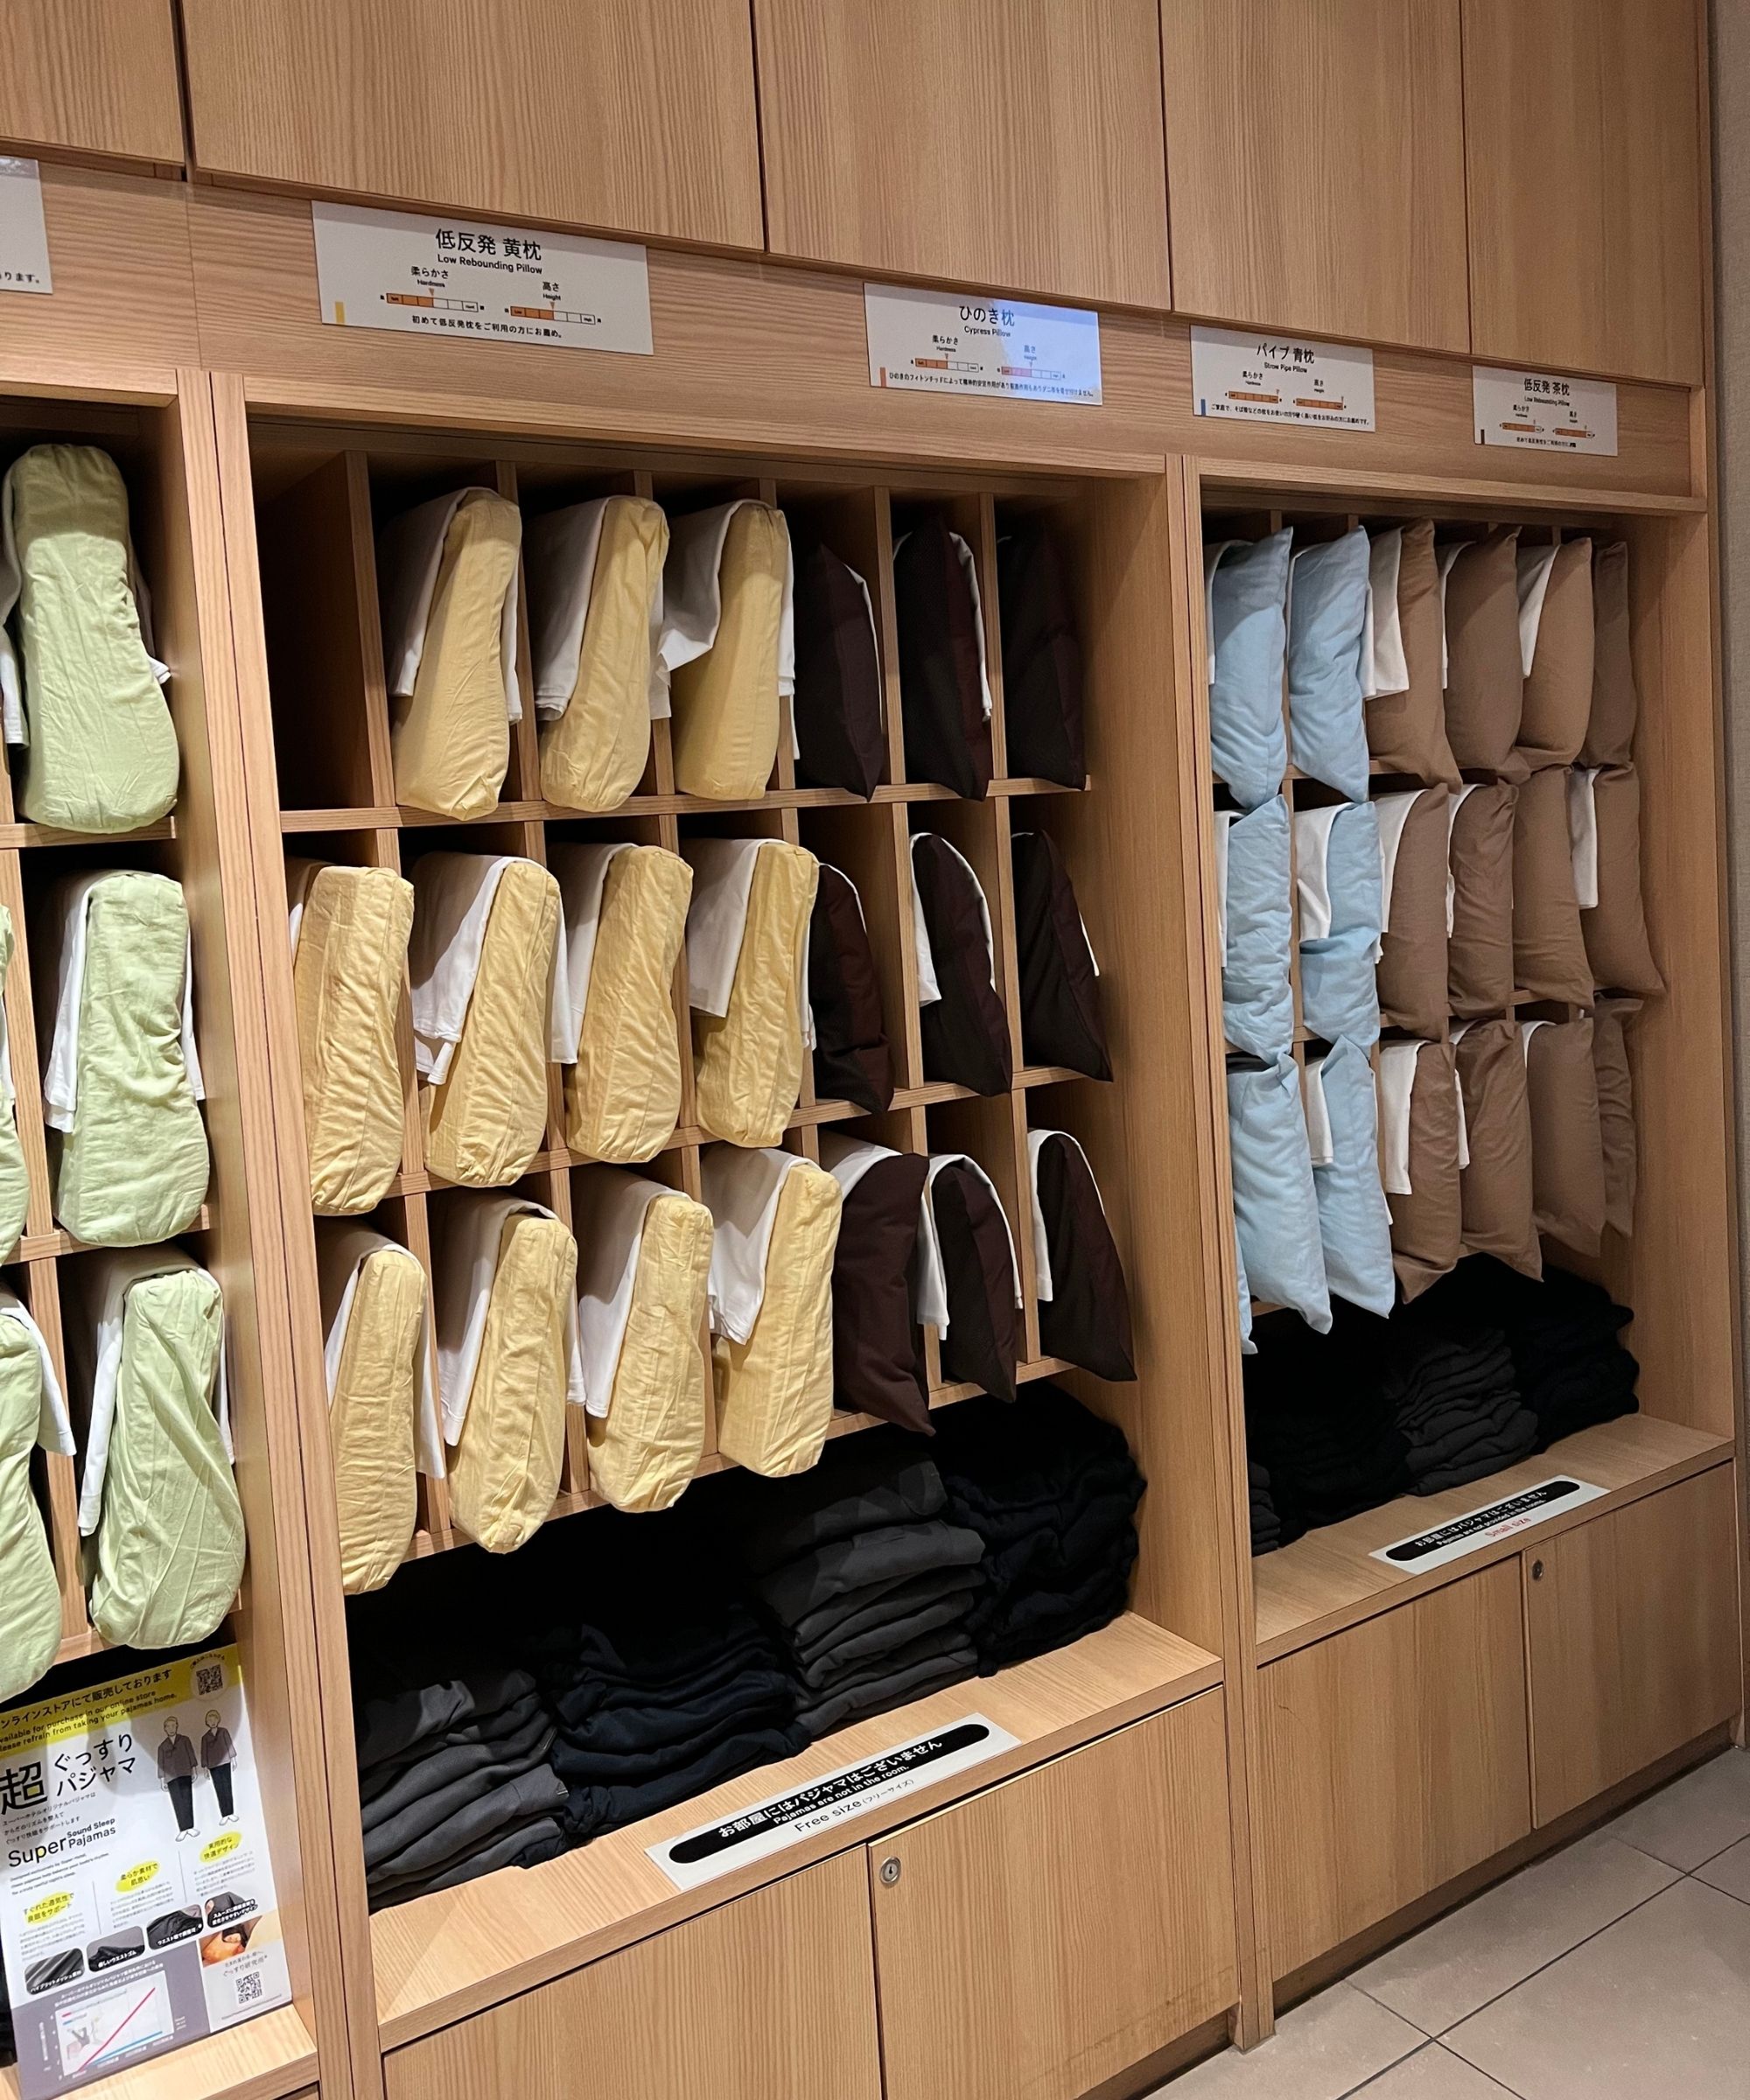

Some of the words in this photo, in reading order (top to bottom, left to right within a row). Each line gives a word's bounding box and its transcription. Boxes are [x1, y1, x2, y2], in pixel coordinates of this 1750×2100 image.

[435, 228, 496, 256] 低反発
[503, 237, 542, 261] 黄枕
[411, 265, 449, 279] 柔らかさ
[438, 255, 457, 264] Low
[459, 256, 514, 273] Rebounding
[516, 263, 542, 275] Pillow
[0, 271, 39, 284] ります。
[542, 281, 559, 292] 高さ
[959, 305, 1015, 327] ひのき枕
[964, 326, 990, 337] Cypress
[992, 328, 1011, 338] Pillow
[1292, 347, 1315, 364] 青枕
[1524, 378, 1550, 394] 低反発
[1485, 1524, 1513, 1537] Small
[1512, 1517, 1531, 1528] size
[23, 1730, 51, 1746] refrain
[52, 1724, 72, 1738] from
[74, 1716, 99, 1733] taking
[101, 1710, 119, 1726] your
[121, 1700, 152, 1718] pajamas
[32, 1724, 45, 1735] for
[46, 1714, 84, 1731] purchase
[94, 1705, 108, 1715] our
[136, 1690, 156, 1702] store
[54, 1733, 132, 1773] ぐっすり
[57, 1756, 136, 1796] パジャマ
[0, 1760, 48, 1815] 超
[718, 1740, 942, 1838] お部屋にはパジャマはございません
[774, 1804, 816, 1824] Pajamas
[818, 1796, 835, 1807] are
[835, 1788, 852, 1801] not
[864, 1776, 880, 1787] the
[881, 1766, 909, 1779] room.
[66, 1825, 92, 1838] Sound
[94, 1818, 116, 1830] Sleep
[794, 1814, 830, 1832] Free
[68, 1827, 116, 1849] Pajamas
[8, 1837, 67, 1867] Super
